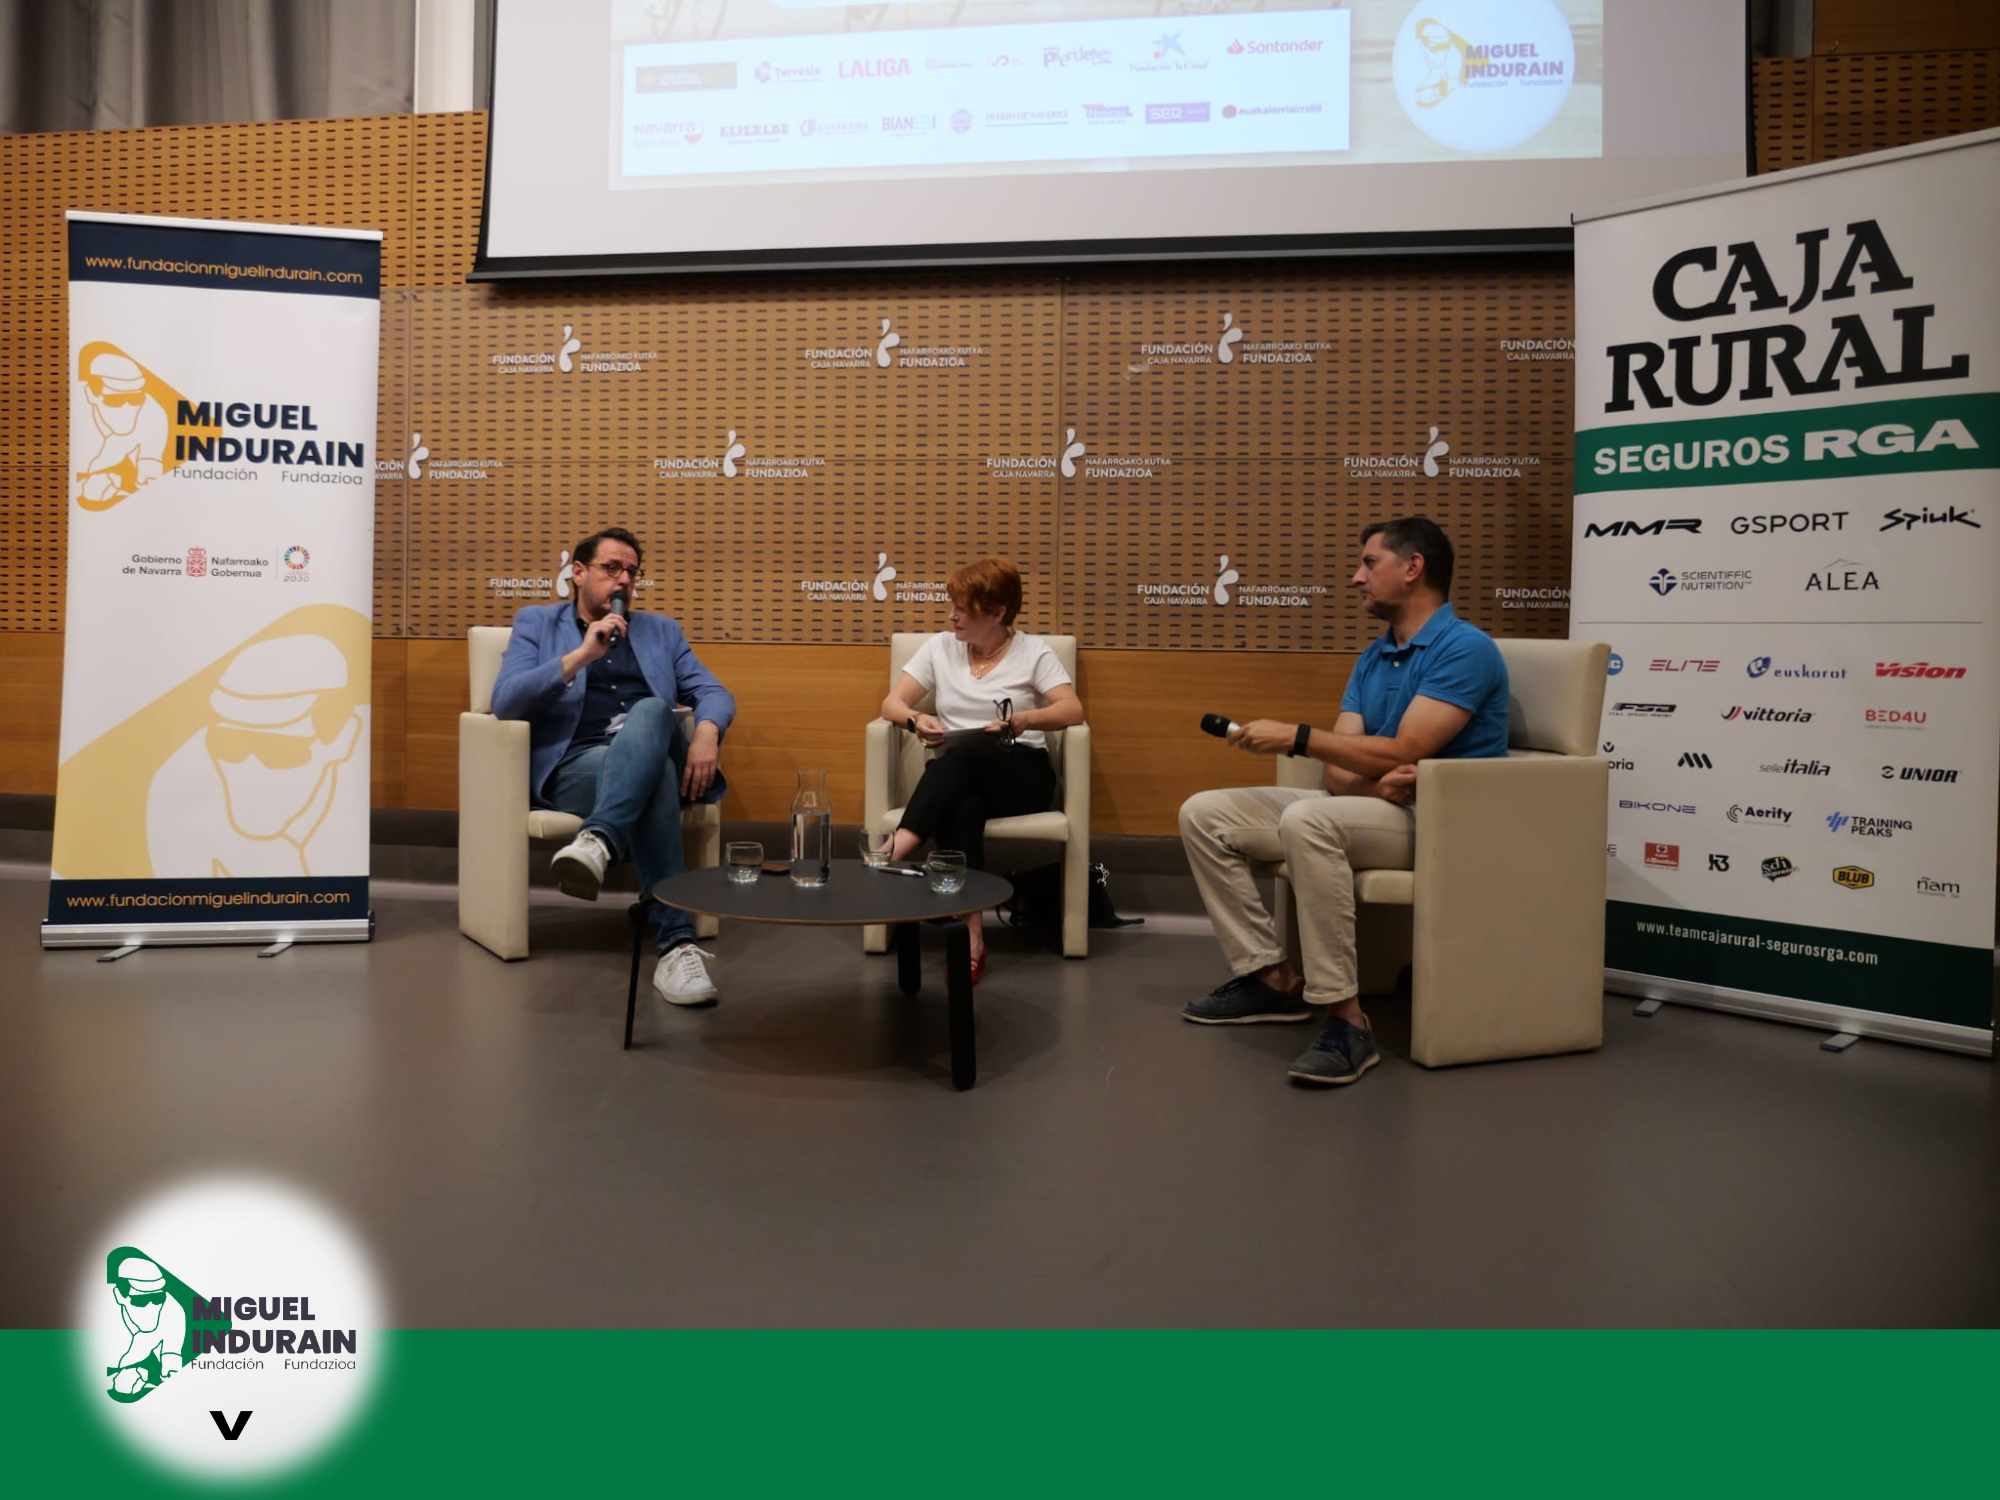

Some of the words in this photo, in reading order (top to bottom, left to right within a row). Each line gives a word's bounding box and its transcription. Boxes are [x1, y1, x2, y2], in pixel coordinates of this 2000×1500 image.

[1247, 39, 1324, 54] Santander
[1465, 43, 1539, 59] MIGUEL
[838, 57, 911, 78] LALIGA
[1464, 61, 1564, 78] INDURAIN
[85, 255, 363, 284] www.fundacionmiguelindurain.com
[1653, 219, 1914, 322] CAJA
[804, 346, 872, 359] FUNDACIÓN
[900, 347, 955, 355] NAFARROAKO
[957, 346, 983, 355] KUTXA
[1141, 342, 1213, 355] FUNDACIÓN
[1243, 343, 1302, 351] NAFARROAKO
[1304, 342, 1331, 350] KUTXA
[493, 351, 555, 365] FUNDACIÓN
[581, 352, 630, 360] NAFARROAKO
[632, 351, 658, 359] KUTXA
[900, 356, 965, 367] FUNDAZIOA
[1147, 356, 1169, 365] CAJA
[1171, 356, 1212, 364] NAVARRA
[1243, 352, 1312, 363] FUNDAZIOA
[1507, 352, 1530, 361] CAJA
[1532, 352, 1575, 360] NAVARRA
[1604, 304, 1970, 414] RURAL
[498, 366, 518, 374] CAJA
[519, 365, 554, 374] NAVARRA
[581, 362, 641, 373] FUNDAZIOA
[811, 361, 830, 369] CAJA
[832, 360, 871, 368] NAVARRA
[177, 400, 318, 431] MIGUEL
[175, 435, 364, 468] INDURAIN
[1594, 435, 1789, 475] SEGUROS
[1804, 419, 1979, 461] RGA
[480, 460, 503, 468] KUTXA
[654, 457, 719, 469] FUNDACIÓN
[745, 459, 799, 467] NAFARROAKO
[800, 458, 826, 466] KUTXA
[986, 456, 1056, 468] FUNDACIÓN
[1085, 458, 1143, 466] NAFARROAKO
[1145, 458, 1171, 466] KUTXA
[1344, 455, 1418, 468] FUNDACIÓN
[1449, 457, 1511, 466] NAFARROAKO
[1512, 457, 1540, 465] KUTXA
[173, 466, 258, 481] Fundación
[282, 470, 363, 485] Fundazioa
[429, 469, 487, 479] FUNDAZIOA
[659, 470, 679, 478] CAJA
[681, 470, 718, 478] NAVARRA
[745, 468, 808, 478] FUNDAZIOA
[992, 470, 1014, 478] CAJA
[1015, 470, 1055, 478] NAVARRA
[1085, 468, 1153, 478] FUNDAZIOA
[1350, 470, 1373, 478] CAJA
[1374, 470, 1417, 478] NAVARRA
[1449, 468, 1521, 478] FUNDAZIOA
[1584, 518, 1703, 538] MMR
[1730, 511, 1849, 535] GSPORT
[132, 554, 182, 564] Gobierno
[211, 557, 269, 567] Nafarroako
[122, 566, 136, 575] de
[139, 567, 182, 576] Navarra
[211, 568, 262, 578] Gobernua
[1681, 570, 1752, 581] SCIENTIFFIC
[490, 576, 552, 588] FUNDACIÓN
[801, 579, 869, 591] FUNDACIÓN
[896, 582, 947, 590] NAFARROAK
[1805, 571, 1880, 591] ALEA
[1137, 582, 1209, 595] FUNDACIÓN
[1239, 586, 1298, 594] NAFARROAKO
[1300, 586, 1327, 594] KUTXA
[896, 592, 952, 602] FUNDAZIO
[1143, 597, 1165, 605] CAJA
[1167, 597, 1208, 606] NAVARRA
[1239, 596, 1308, 606] FUNDAZIOA
[1501, 601, 1524, 609] CAJA
[1743, 708, 1813, 723] vittoria
[1865, 710, 1927, 723] BED4U
[1900, 767, 1959, 783] UNIOR
[1619, 800, 1697, 814] BIKONE
[1745, 806, 1792, 823] Aerify
[1851, 816, 1913, 831] TRAINING
[1851, 826, 1893, 838] PEAKS
[1838, 871, 1870, 884] BLUB
[67, 891, 350, 908] www.fundacionmiguelindurain.com
[1637, 919, 1878, 965] www.teamcajarural-segurosrga.com
